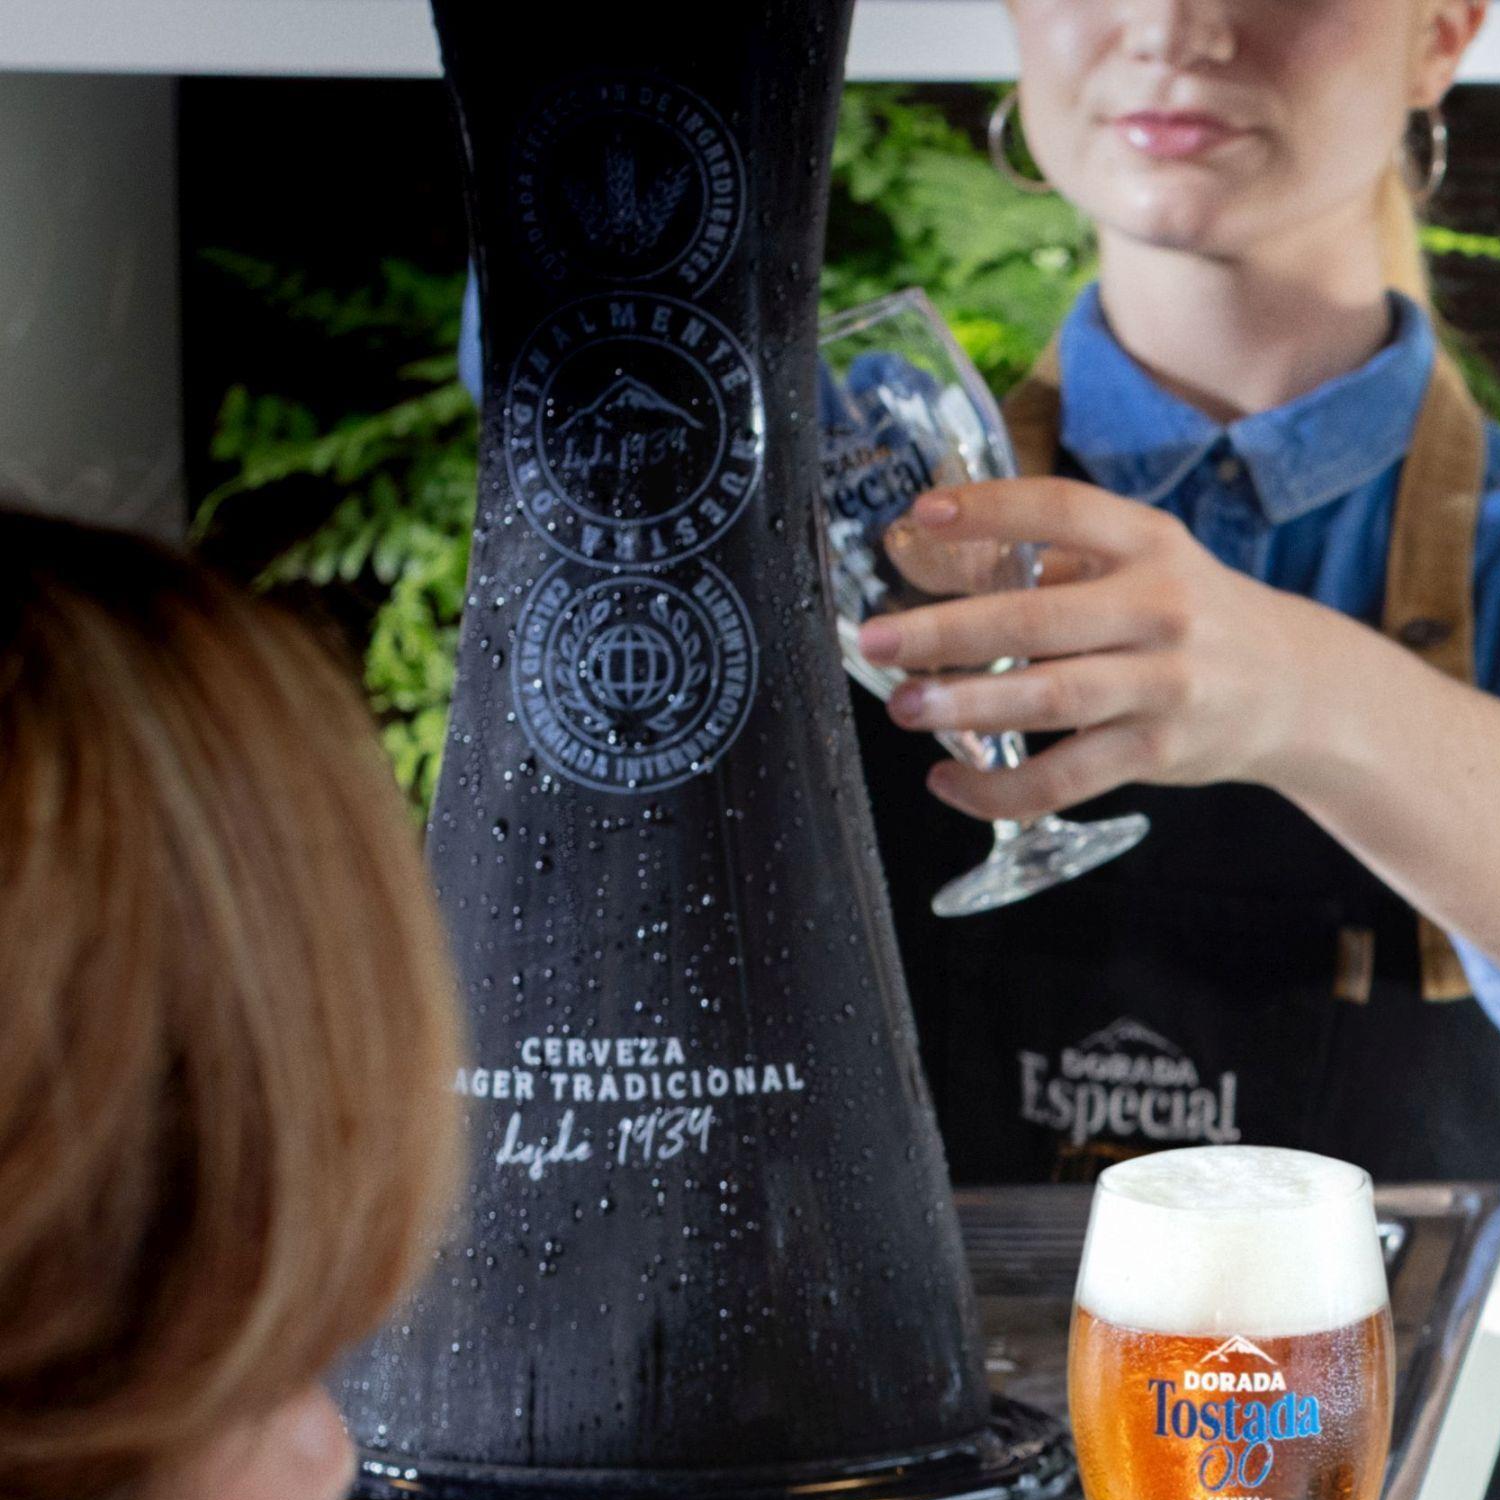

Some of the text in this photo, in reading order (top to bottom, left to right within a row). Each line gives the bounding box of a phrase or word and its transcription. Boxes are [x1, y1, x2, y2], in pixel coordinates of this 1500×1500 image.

[826, 440, 935, 522] ecial
[521, 1036, 686, 1067] CERVEZA
[1061, 1047, 1199, 1088] DORADA
[453, 1062, 805, 1102] AGER TRADICIONAL
[1018, 1049, 1242, 1148] Especial
[617, 1104, 715, 1166] 1934
[1183, 1370, 1287, 1392] DORADA
[1148, 1379, 1322, 1443] Tostada
